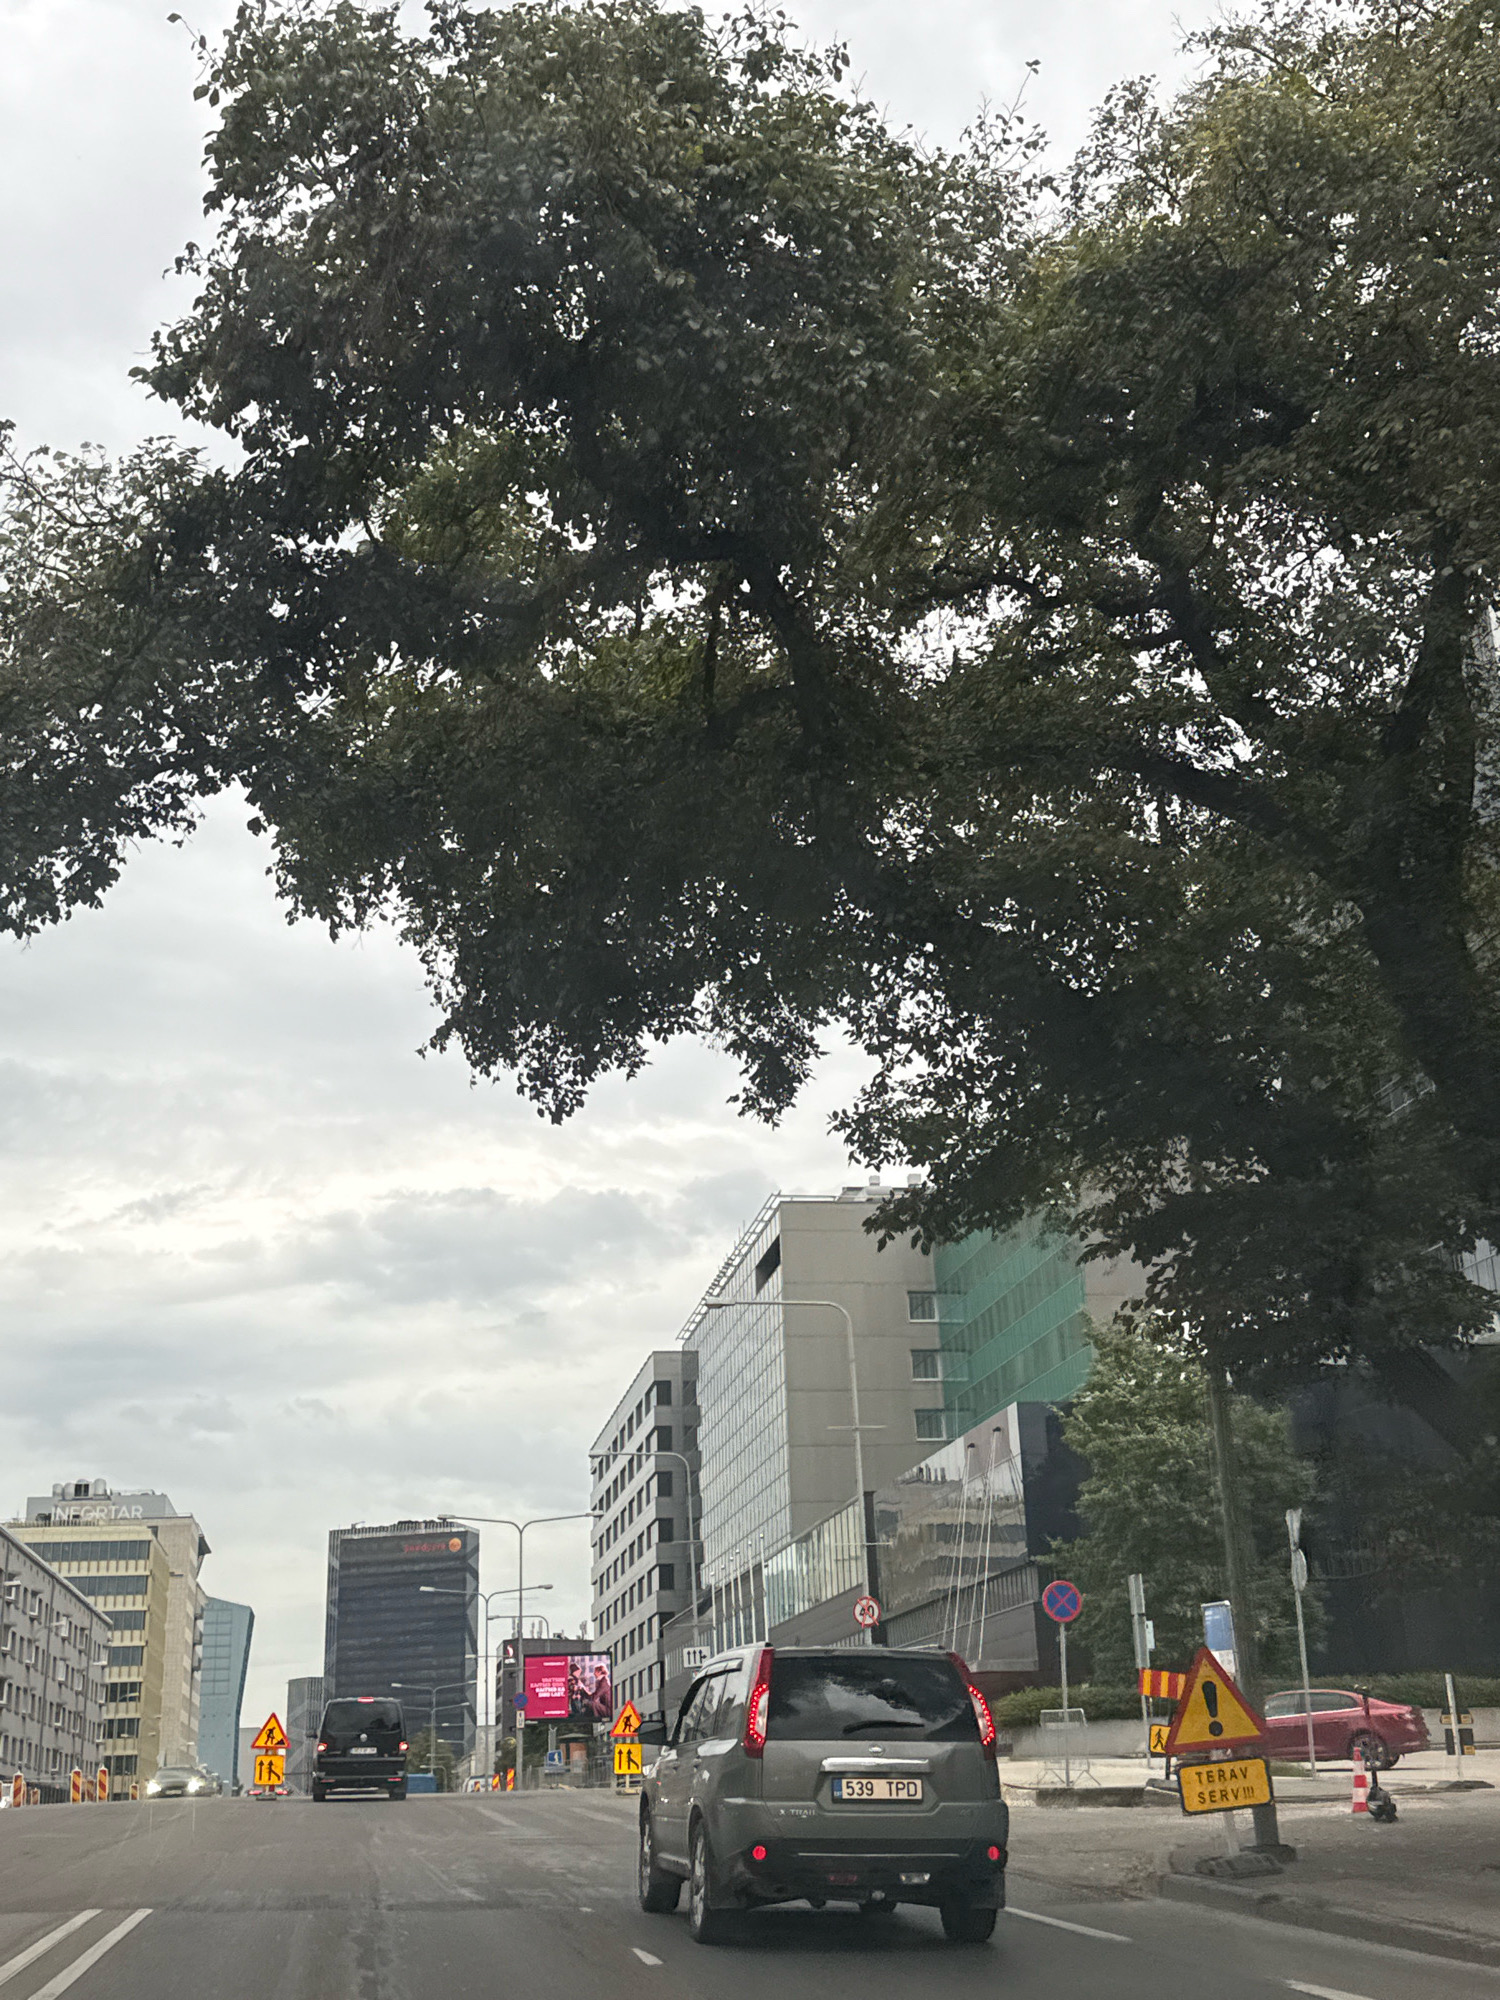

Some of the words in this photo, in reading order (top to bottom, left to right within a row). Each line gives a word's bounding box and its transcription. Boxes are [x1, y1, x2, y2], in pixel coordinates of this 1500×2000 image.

[1195, 1767, 1248, 1785] TERAV
[846, 1781, 874, 1797] 539
[886, 1781, 918, 1797] TPD
